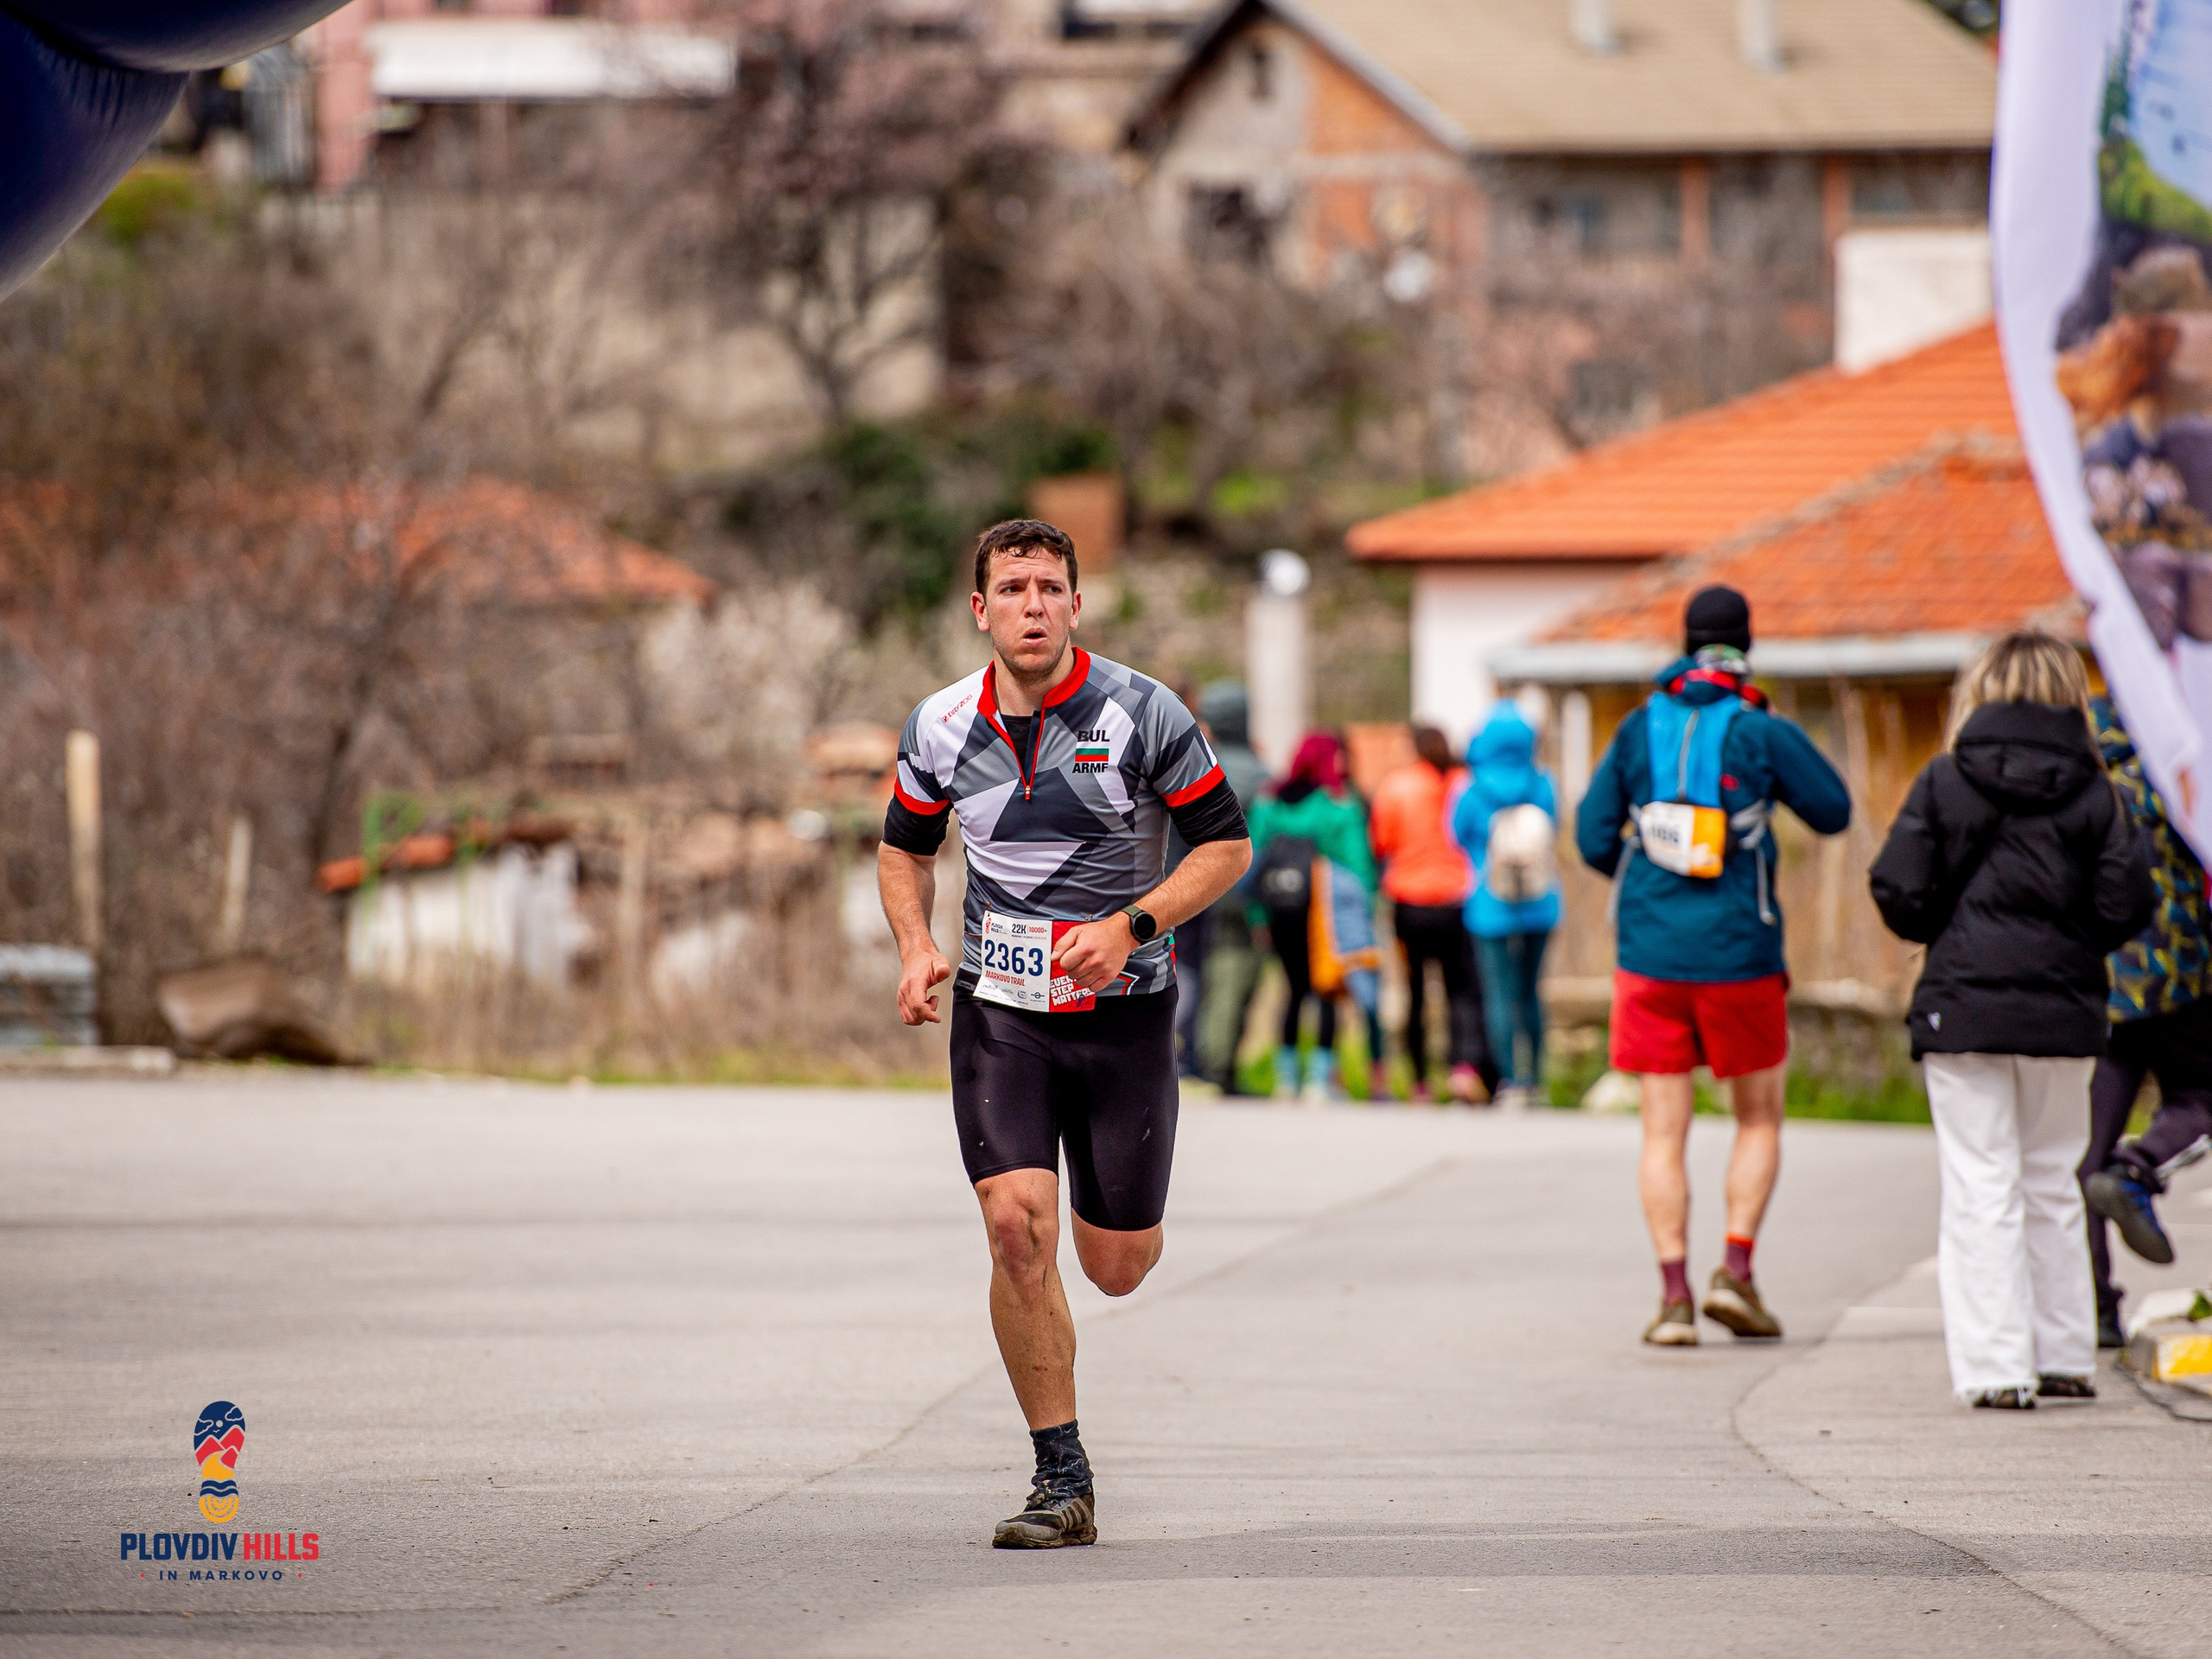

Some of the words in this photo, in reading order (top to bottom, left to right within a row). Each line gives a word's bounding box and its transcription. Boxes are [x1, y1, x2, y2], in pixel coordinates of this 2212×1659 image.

[1077, 729, 1110, 742] BUL
[1072, 763, 1109, 773] ARMF
[1012, 924, 1027, 934] 22K
[984, 939, 1044, 976] 2363
[985, 970, 1010, 983] MARKOVO
[1011, 976, 1026, 986] TRAIL
[1051, 983, 1074, 997] STEP
